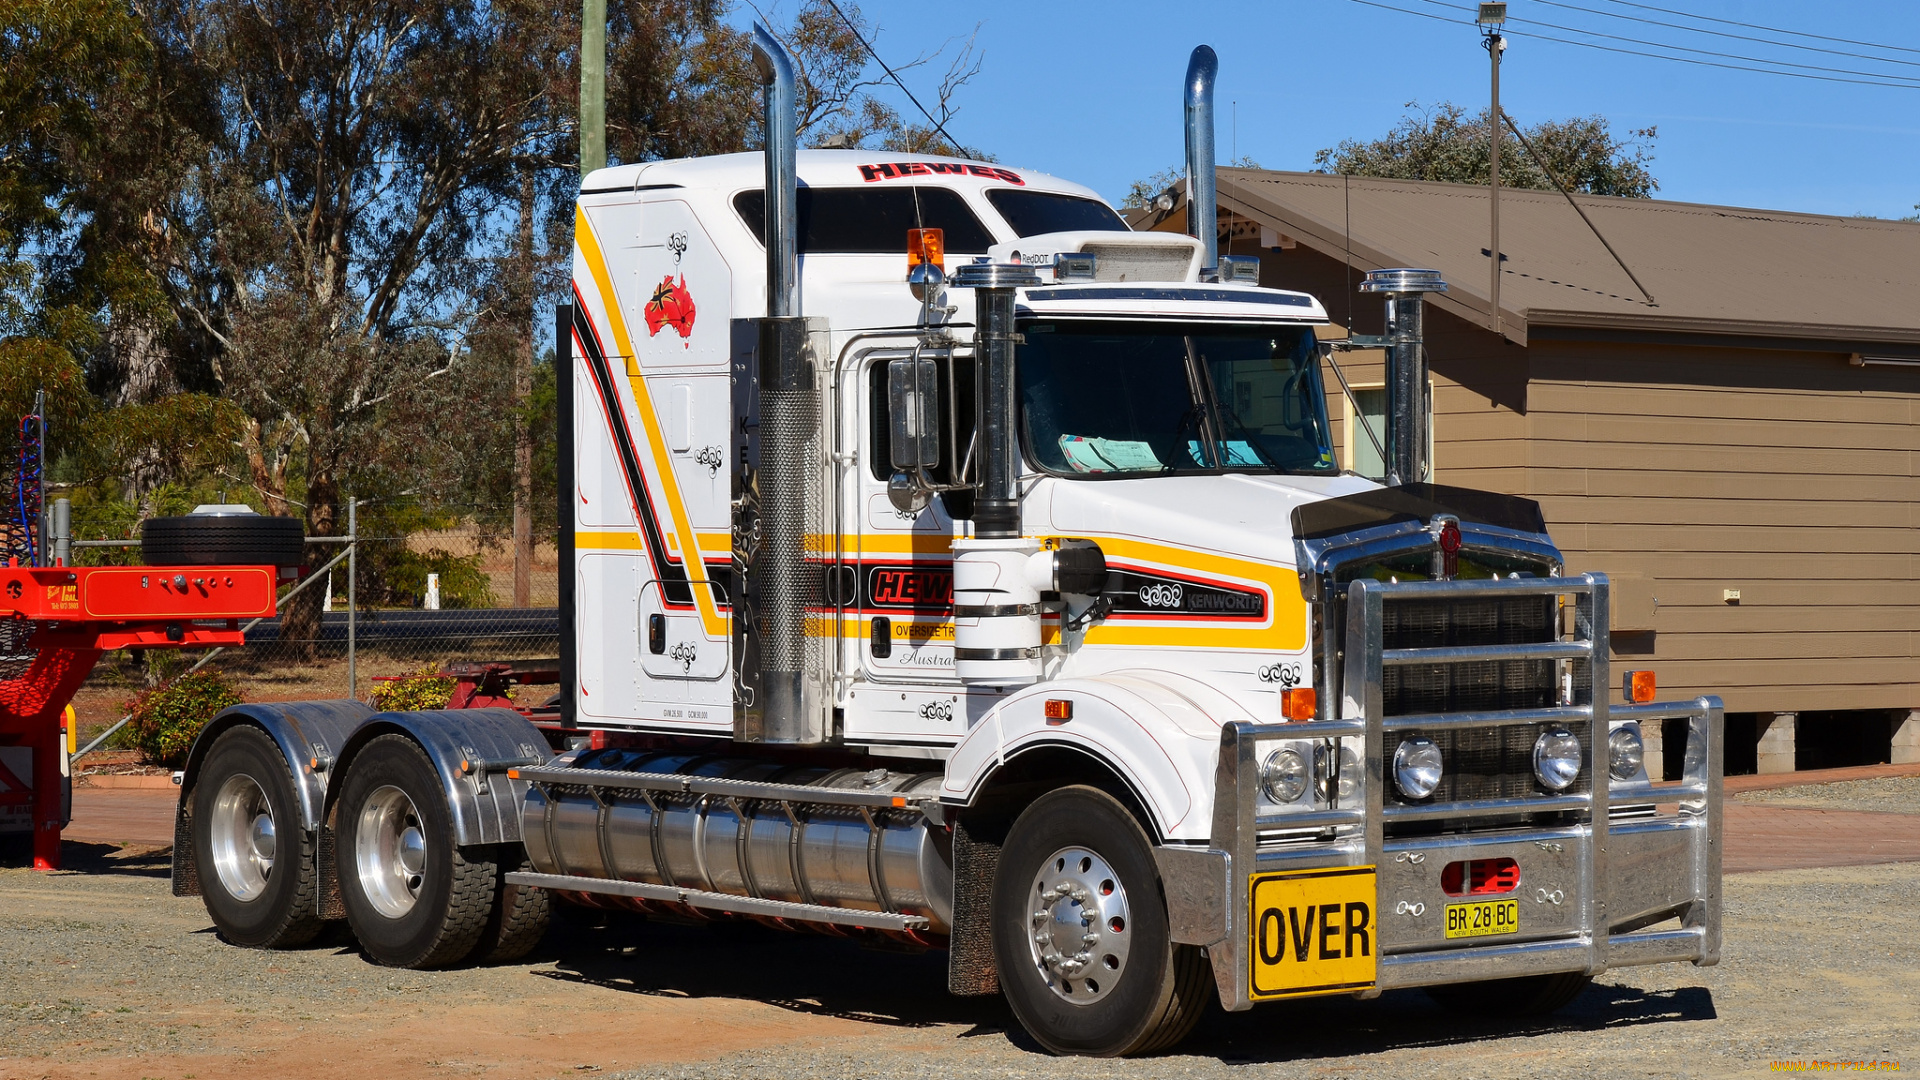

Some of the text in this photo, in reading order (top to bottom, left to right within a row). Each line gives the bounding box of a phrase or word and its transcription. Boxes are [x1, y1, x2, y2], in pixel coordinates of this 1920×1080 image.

[857, 162, 1026, 187] HEWES
[874, 570, 954, 603] HEW
[1187, 593, 1261, 610] KENWORTH
[896, 625, 941, 637] OVERSIZE
[1258, 902, 1371, 966] OVER
[1470, 928, 1489, 936] SOUTH
